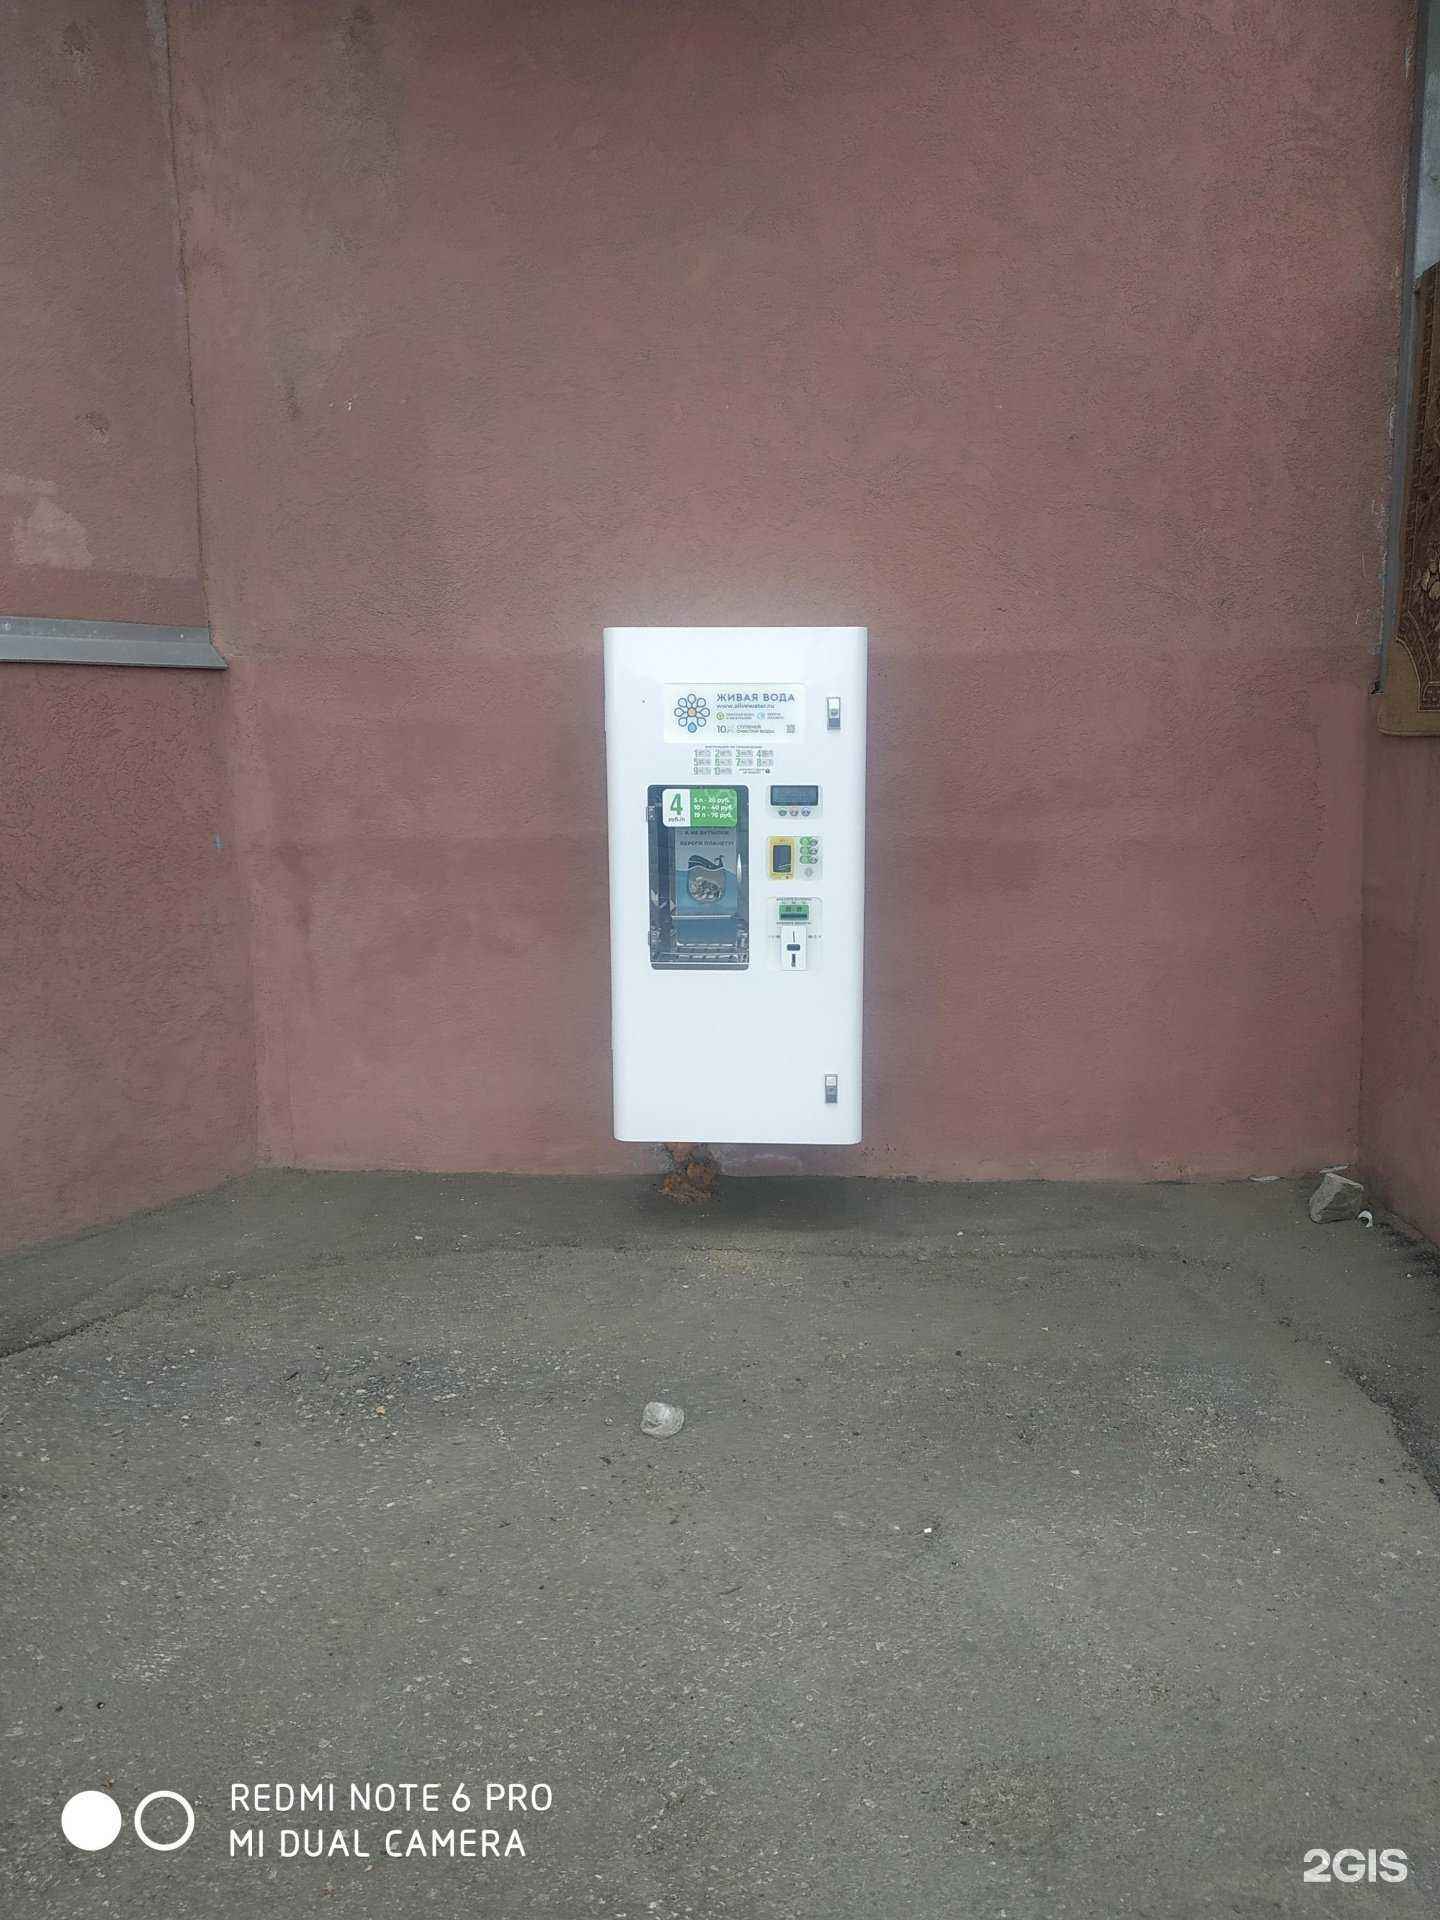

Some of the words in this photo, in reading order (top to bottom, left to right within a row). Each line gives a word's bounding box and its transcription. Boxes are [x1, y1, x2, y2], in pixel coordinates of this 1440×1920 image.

[716, 693, 758, 702] ЖИВАЯ
[763, 693, 795, 702] ВОДА
[716, 725, 726, 733] 10
[670, 793, 683, 815] 4
